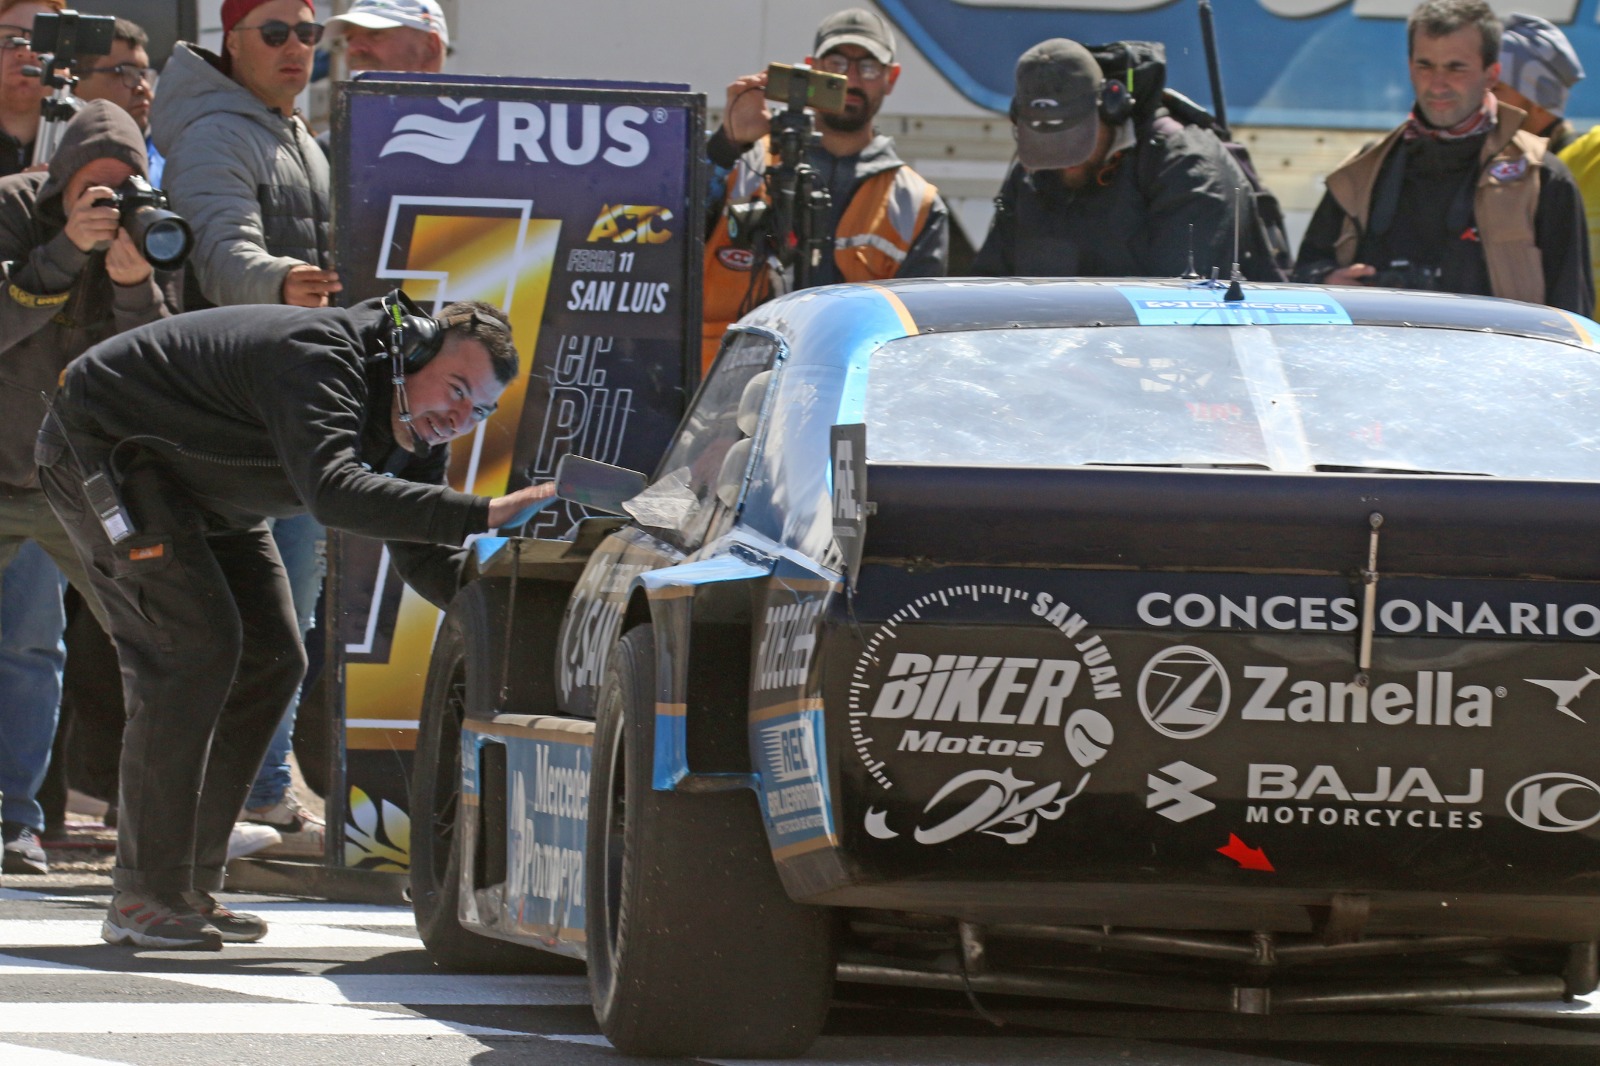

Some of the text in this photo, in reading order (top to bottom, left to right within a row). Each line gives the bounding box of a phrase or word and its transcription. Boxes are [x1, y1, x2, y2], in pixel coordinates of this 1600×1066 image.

[618, 251, 636, 273] 11
[566, 280, 670, 313] SAN LUIS
[1136, 592, 1600, 637] CONCESONARIO
[1031, 591, 1122, 699] SAN JUAN
[870, 652, 1082, 726] BIKER
[1241, 664, 1493, 727] Zanella
[896, 729, 1045, 757] Motos
[1247, 763, 1484, 804] BAJAJ
[1245, 805, 1484, 829] MOTORCYCLES
[523, 818, 584, 930] Pompeya
